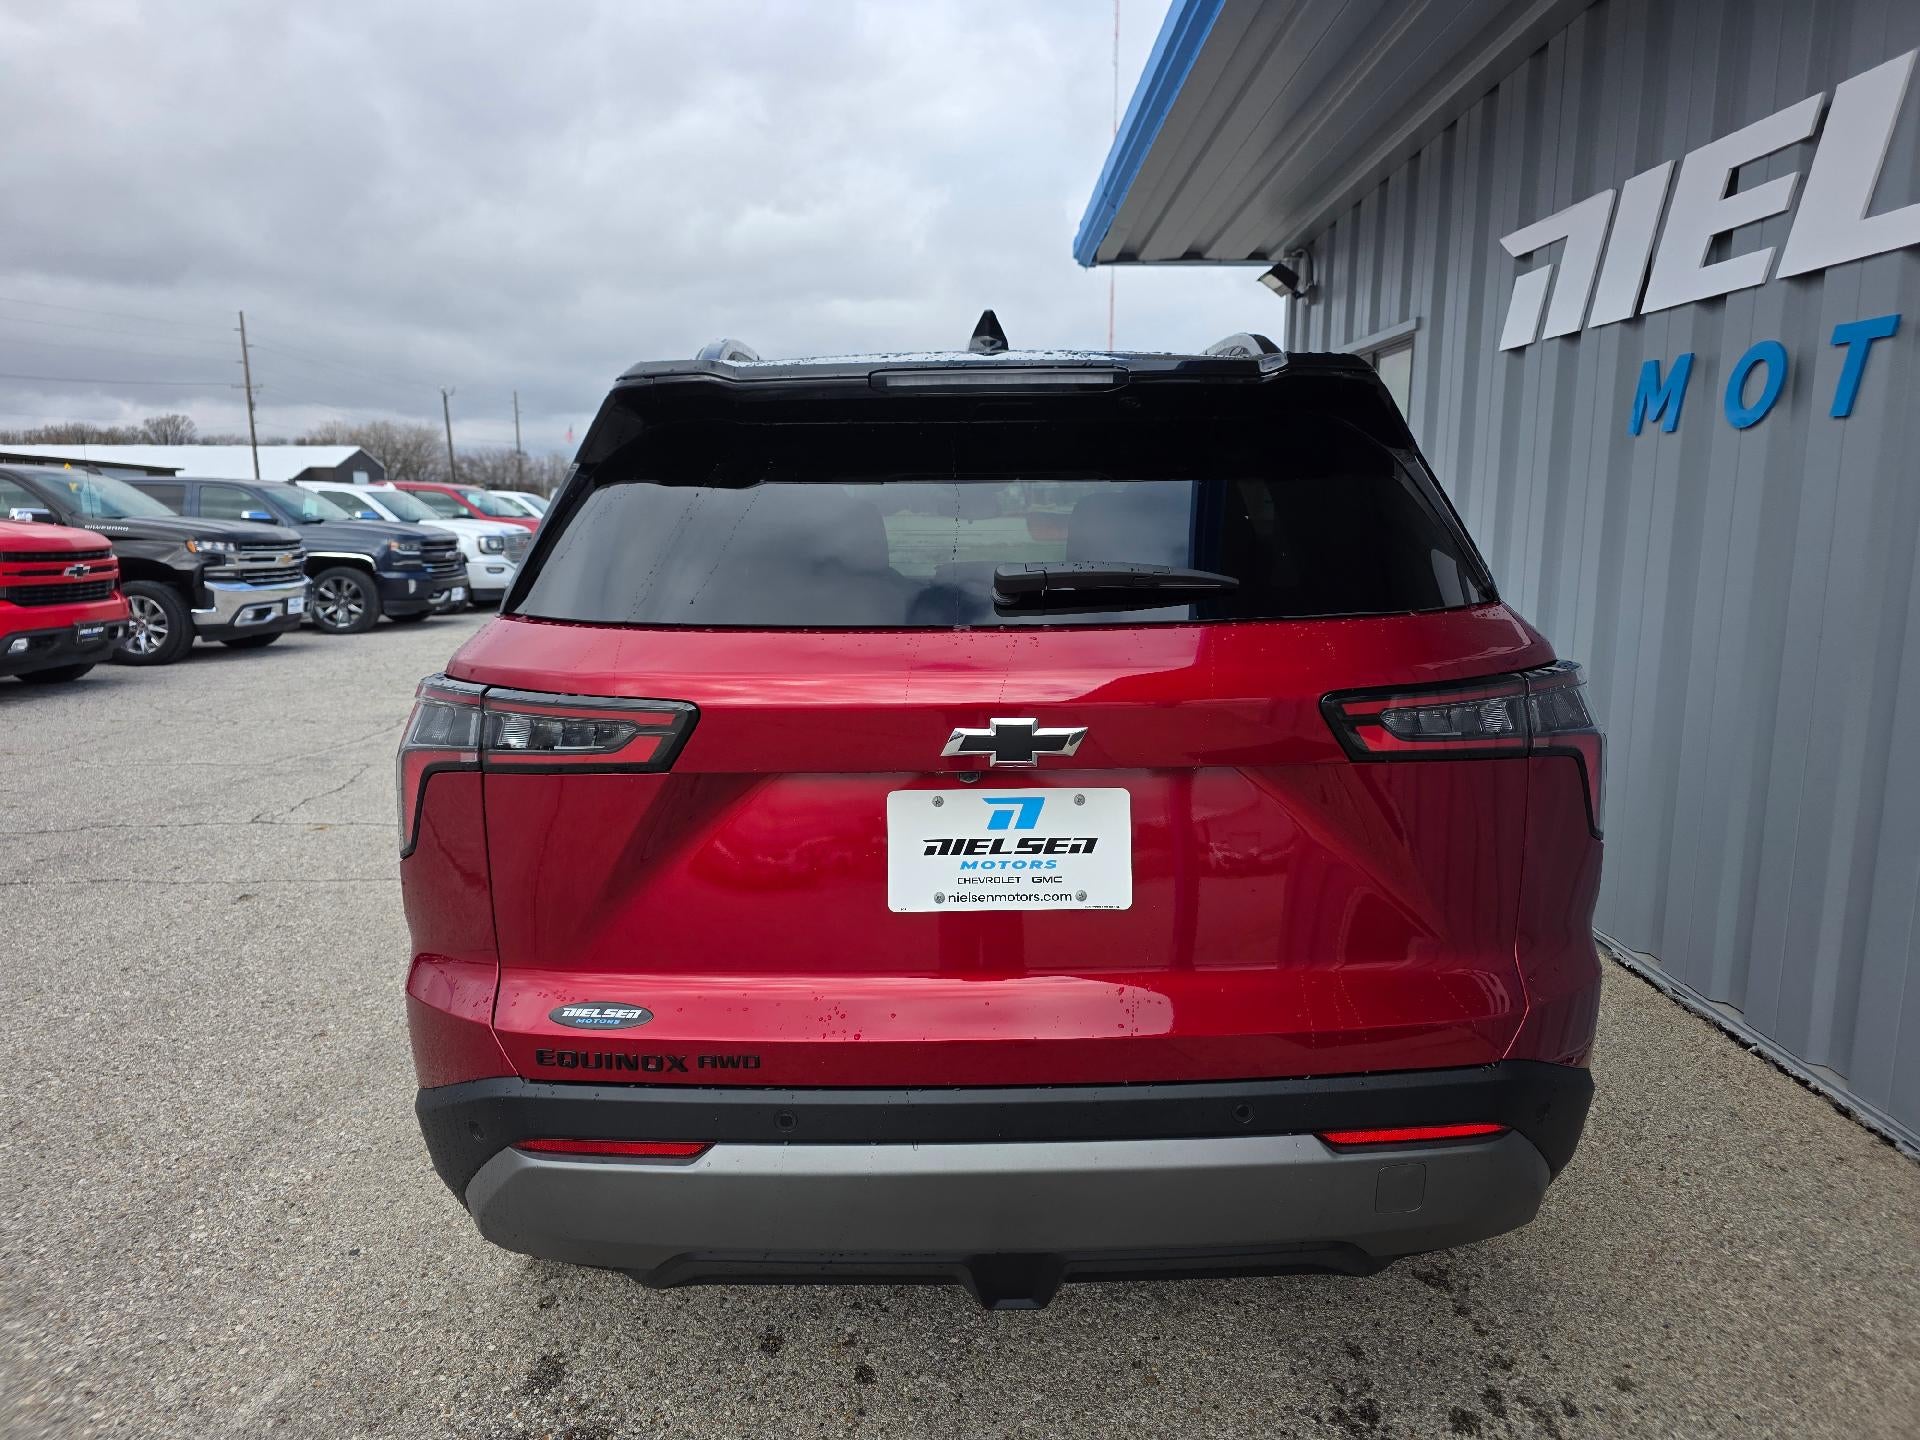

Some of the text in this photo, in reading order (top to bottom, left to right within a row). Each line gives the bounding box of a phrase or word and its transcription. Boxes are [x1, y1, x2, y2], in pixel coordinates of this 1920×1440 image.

[1627, 314, 1902, 437] MOT
[922, 837, 1099, 856] NIELSEN
[959, 859, 1057, 870] MOTORS
[957, 875, 1063, 885] CHEVROLET GMC
[948, 891, 1072, 903] nielsenmotors.com
[561, 1007, 642, 1019] NIELSEN
[536, 1048, 760, 1073] EQUINOX AWD
